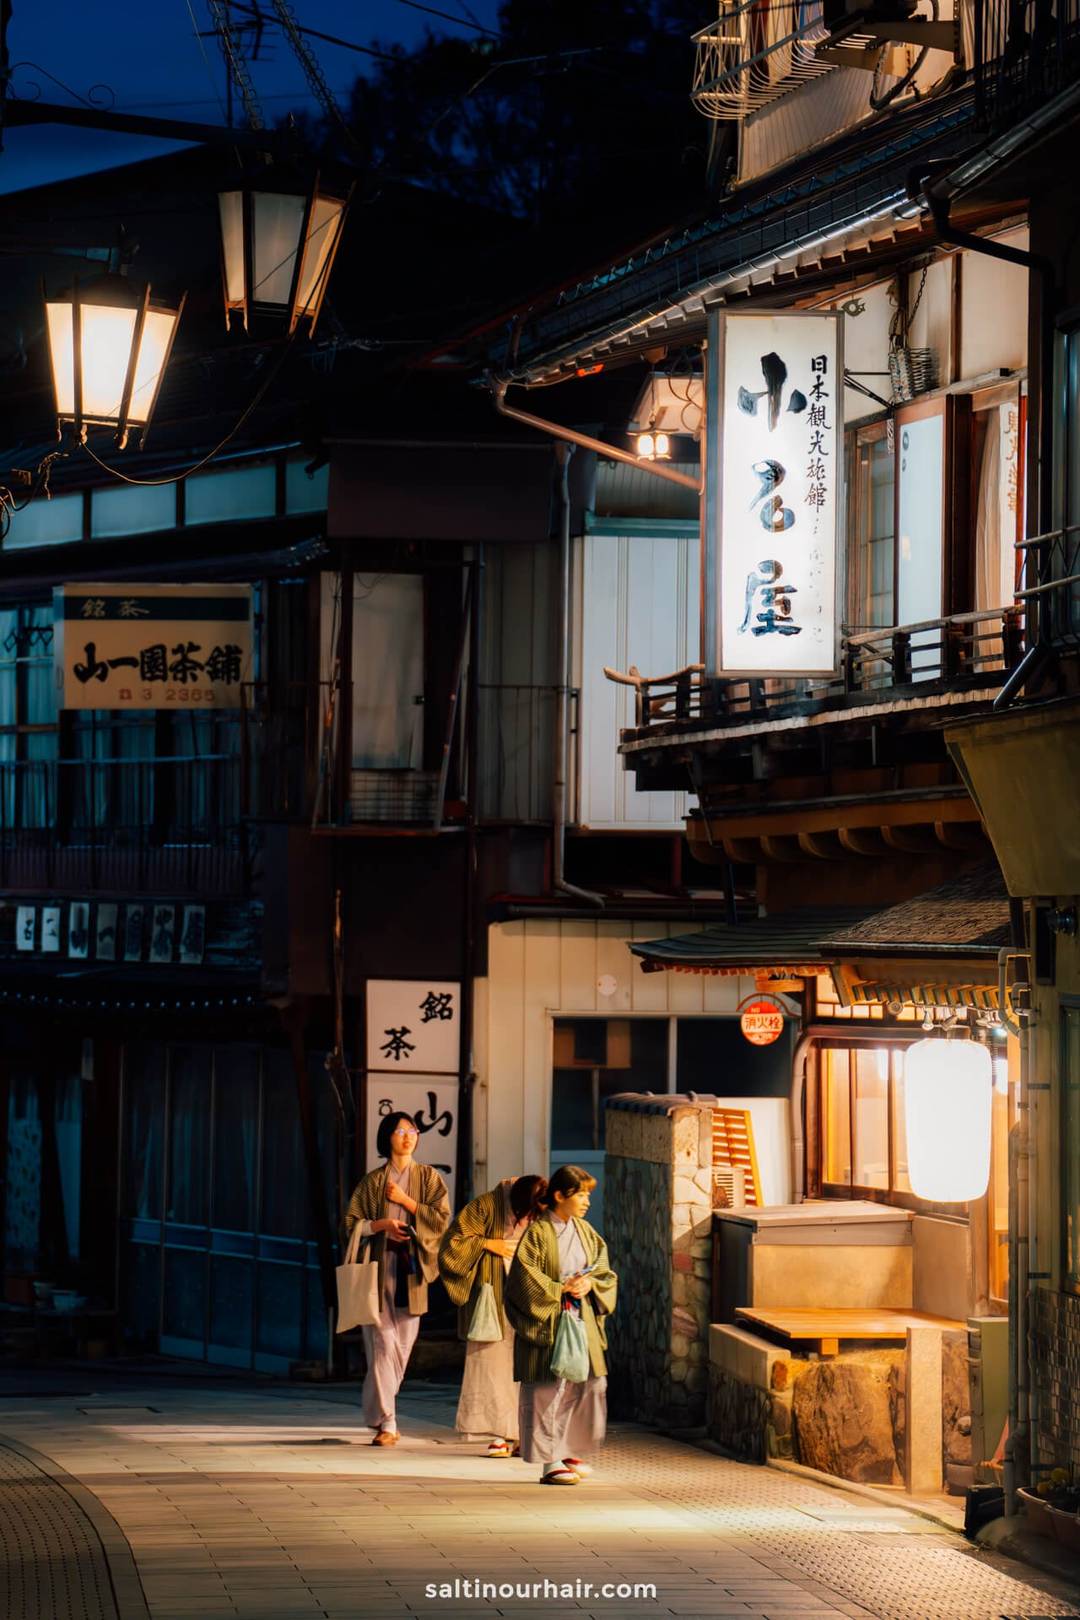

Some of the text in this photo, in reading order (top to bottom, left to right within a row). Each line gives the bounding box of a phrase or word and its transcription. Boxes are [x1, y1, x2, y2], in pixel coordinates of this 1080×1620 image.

[803, 354, 832, 513] 日本観光旅館
[745, 1016, 780, 1029] 消火栓
